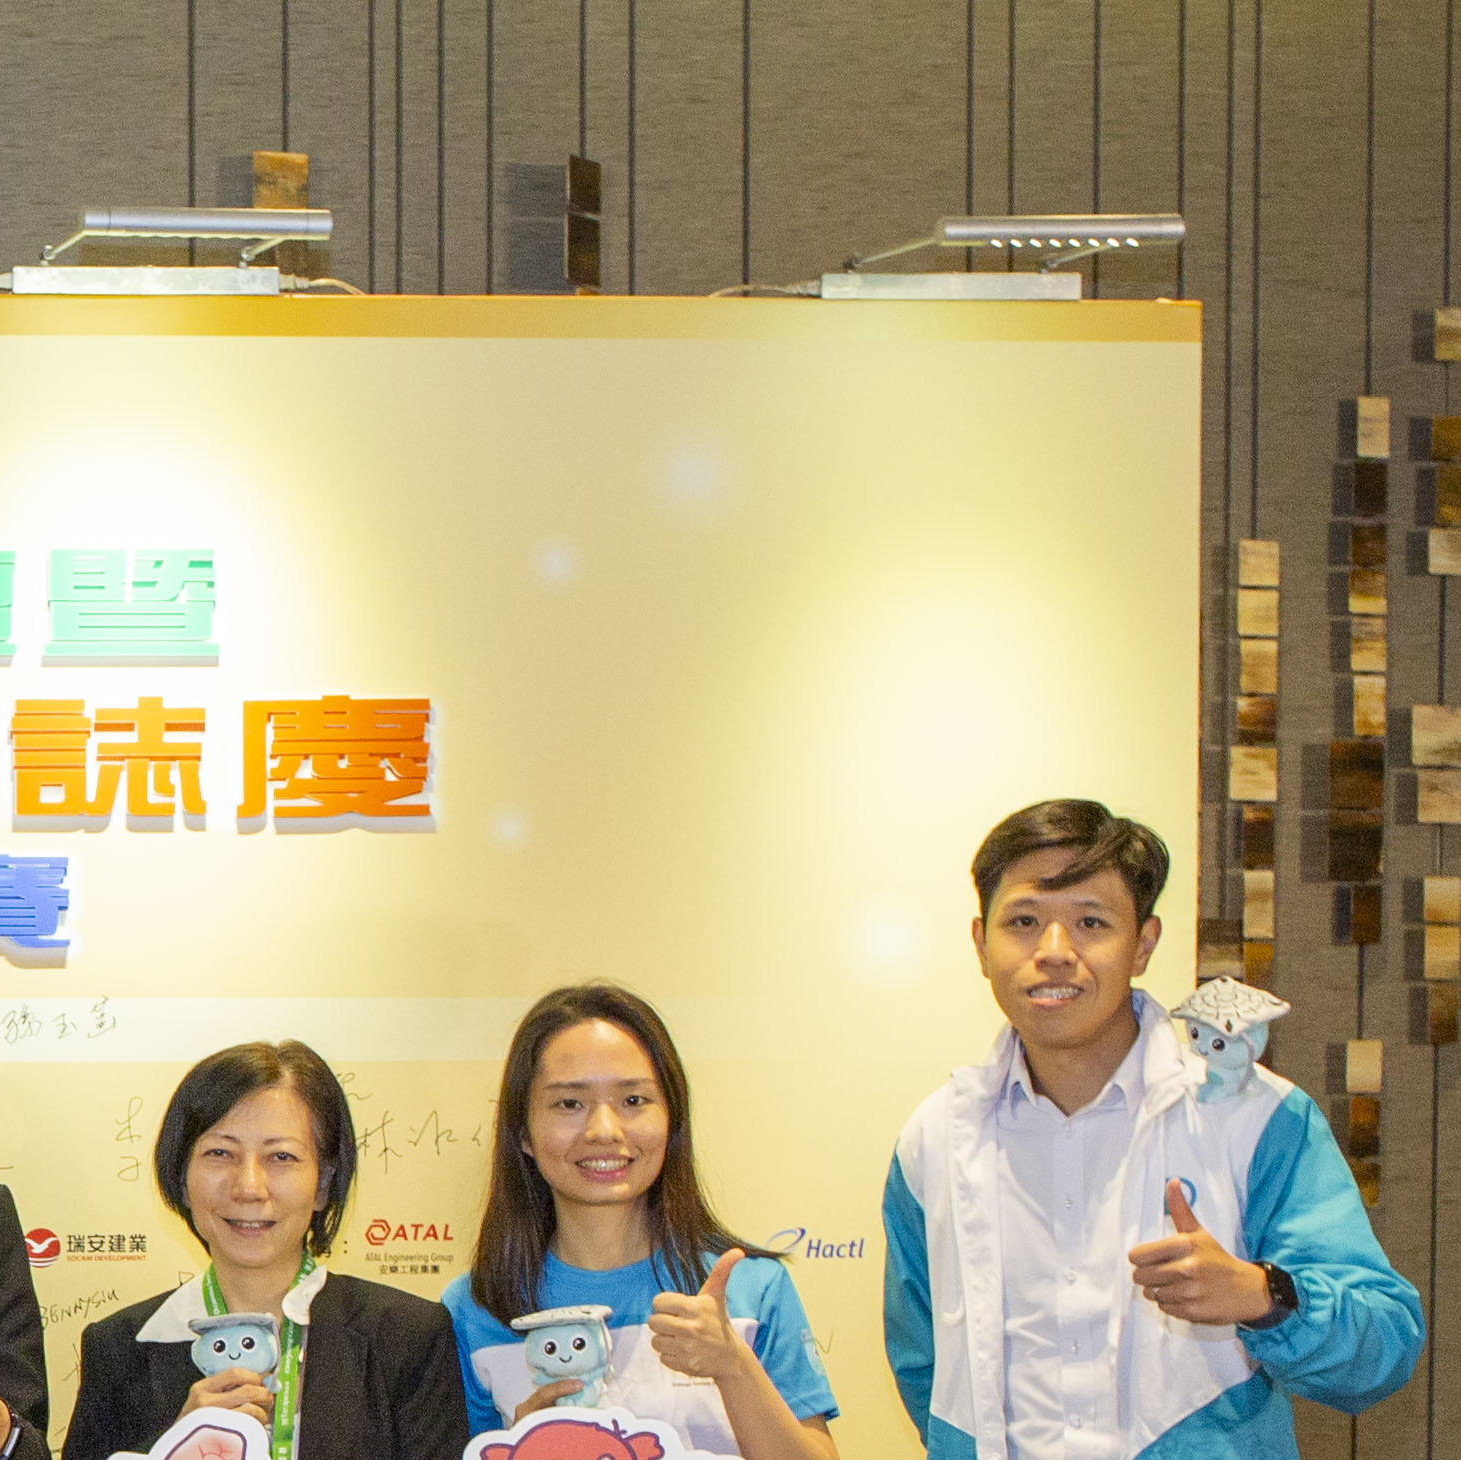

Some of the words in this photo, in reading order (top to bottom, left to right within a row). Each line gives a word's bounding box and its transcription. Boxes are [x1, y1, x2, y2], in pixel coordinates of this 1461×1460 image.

[392, 1223, 454, 1241] ATAL
[66, 1233, 147, 1253] 瑞安建業
[806, 1238, 864, 1258] Hactl
